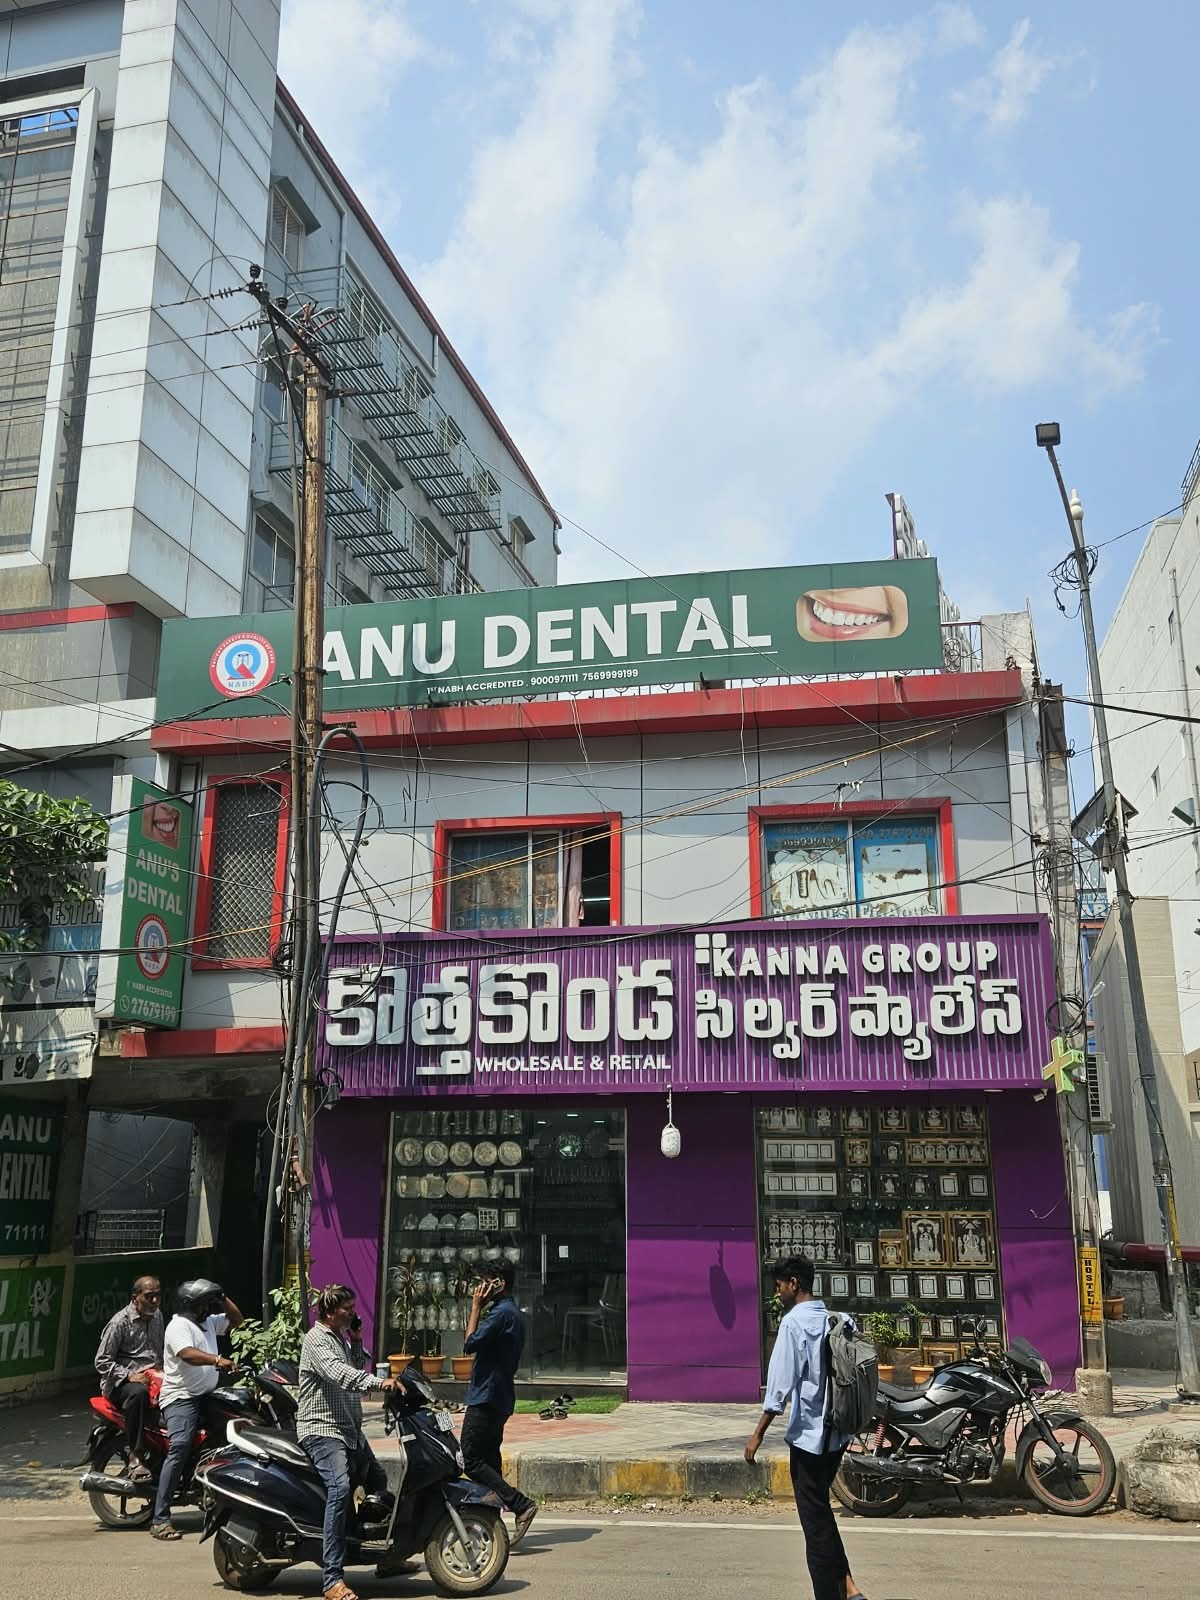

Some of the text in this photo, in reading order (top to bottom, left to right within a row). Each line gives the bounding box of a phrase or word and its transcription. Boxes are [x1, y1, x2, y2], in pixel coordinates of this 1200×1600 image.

[322, 594, 772, 681] ANU DENTAL
[228, 680, 255, 688] NABH
[437, 684, 464, 694] NABH
[465, 679, 524, 692] ACCREDITED
[530, 673, 578, 686] 9000971111
[582, 668, 639, 681] 7569999199
[135, 848, 180, 883] ANU'S
[127, 877, 184, 916] DENTAL
[713, 941, 998, 977] KANNA GROUP
[130, 997, 177, 1023] 27679199
[475, 1054, 672, 1073] WHOLESALE & RETAIL
[0, 1115, 51, 1143] ANU
[1084, 1259, 1095, 1305] HOSTEL
